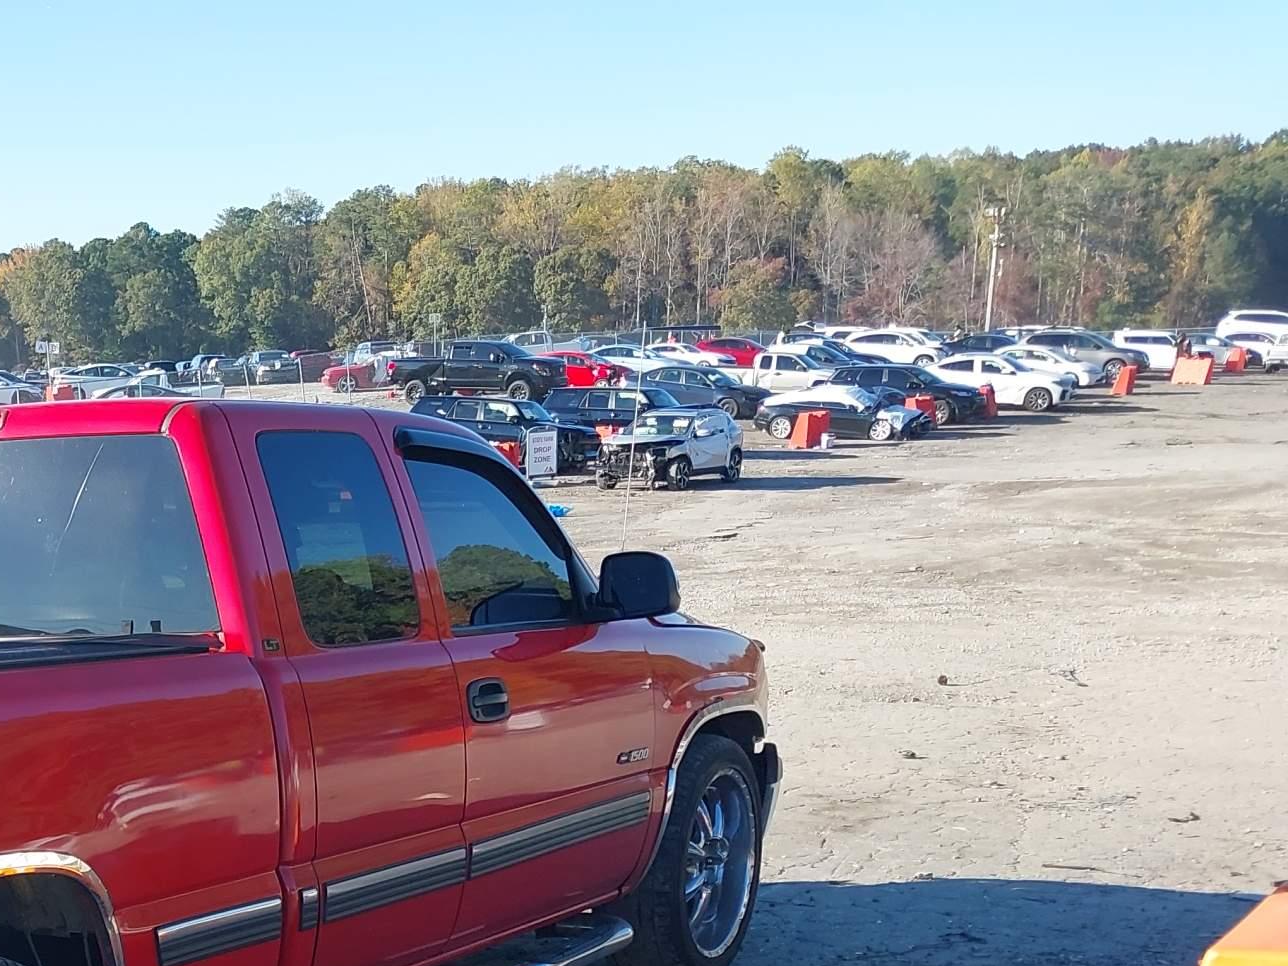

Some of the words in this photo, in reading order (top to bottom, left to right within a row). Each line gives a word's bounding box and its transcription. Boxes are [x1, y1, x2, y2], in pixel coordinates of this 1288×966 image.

[533, 445, 552, 454] DROP
[533, 455, 552, 464] ZONE
[264, 640, 278, 650] LT
[630, 748, 649, 762] 1500
